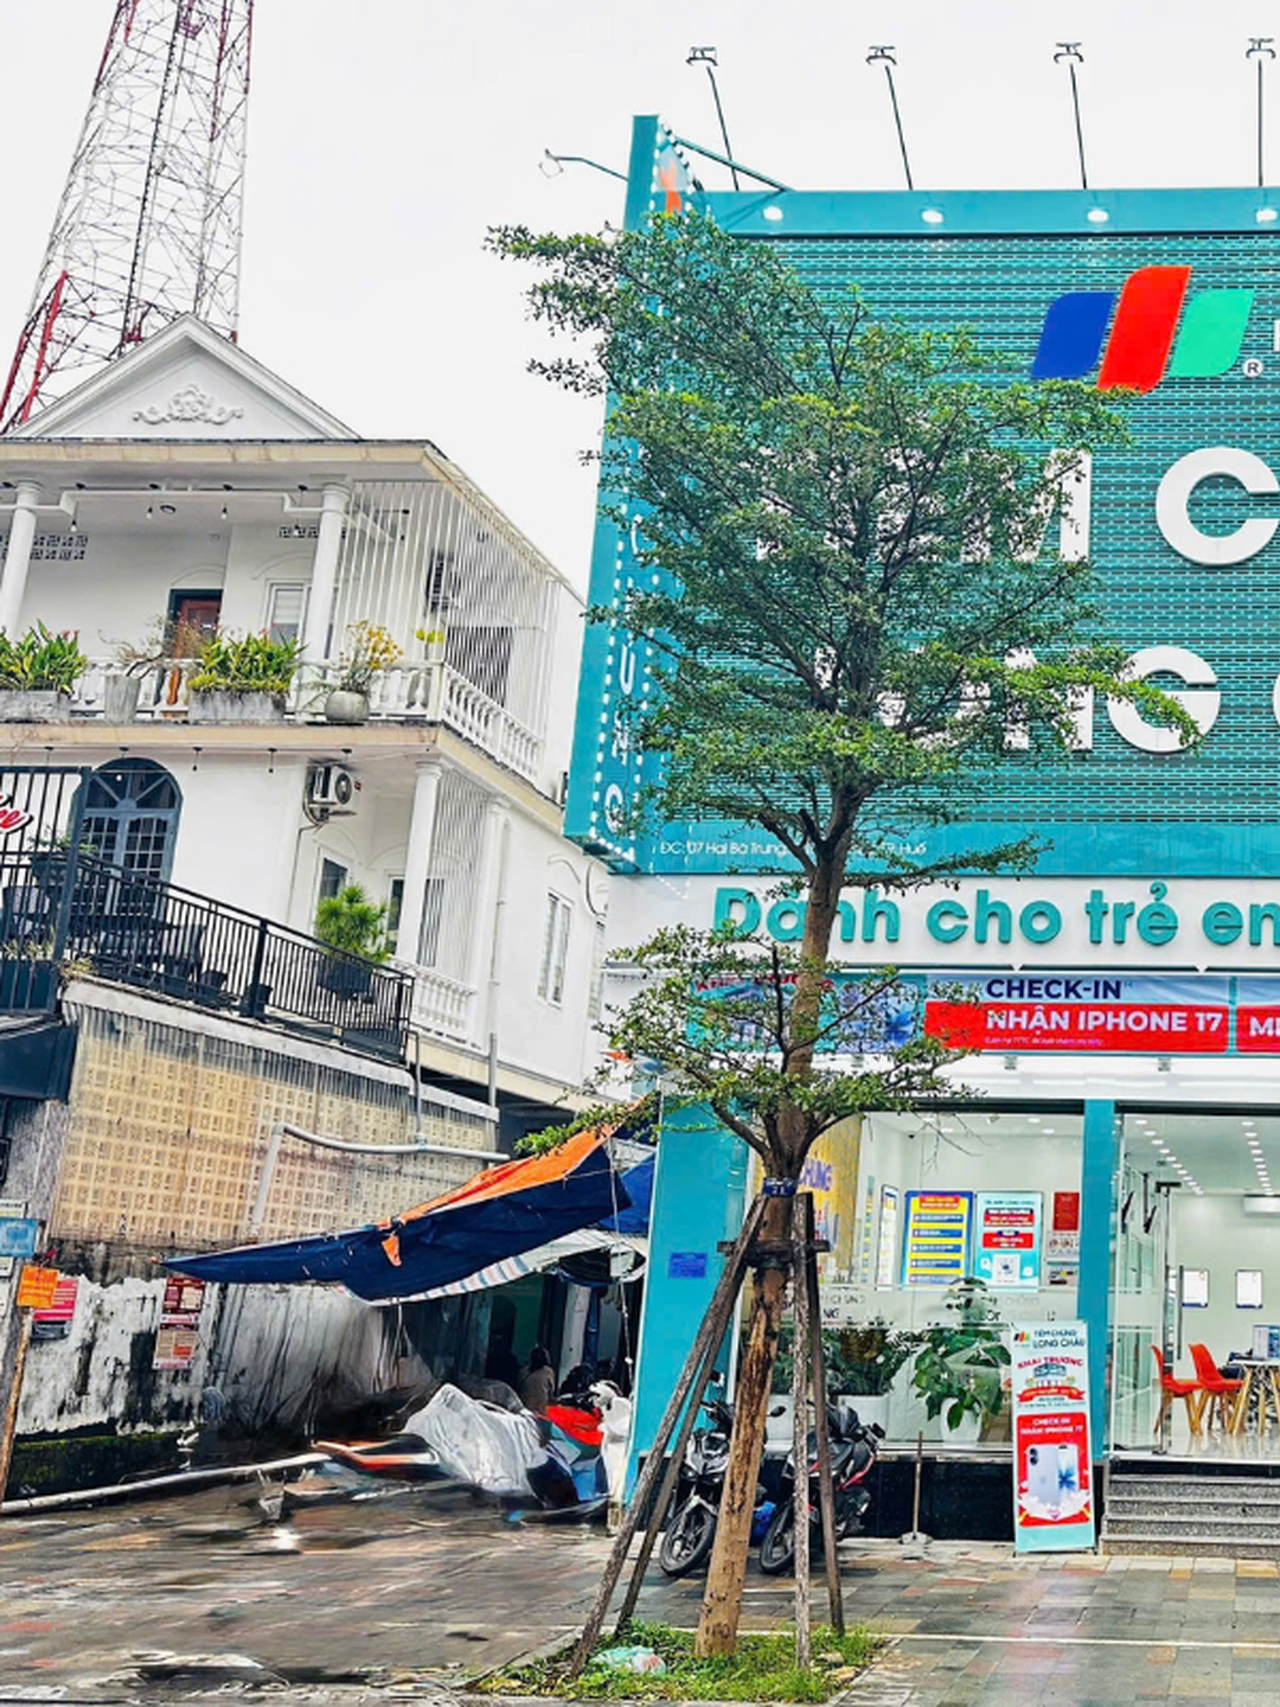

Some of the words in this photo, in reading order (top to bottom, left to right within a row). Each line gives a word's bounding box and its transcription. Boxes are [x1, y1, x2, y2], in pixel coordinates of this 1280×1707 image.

[926, 888, 1062, 944] cho
[1086, 882, 1180, 946] trẻ
[986, 1005, 1071, 1035] NHẬN
[1078, 1010, 1188, 1032] IPHONE
[1195, 1011, 1223, 1032] 17
